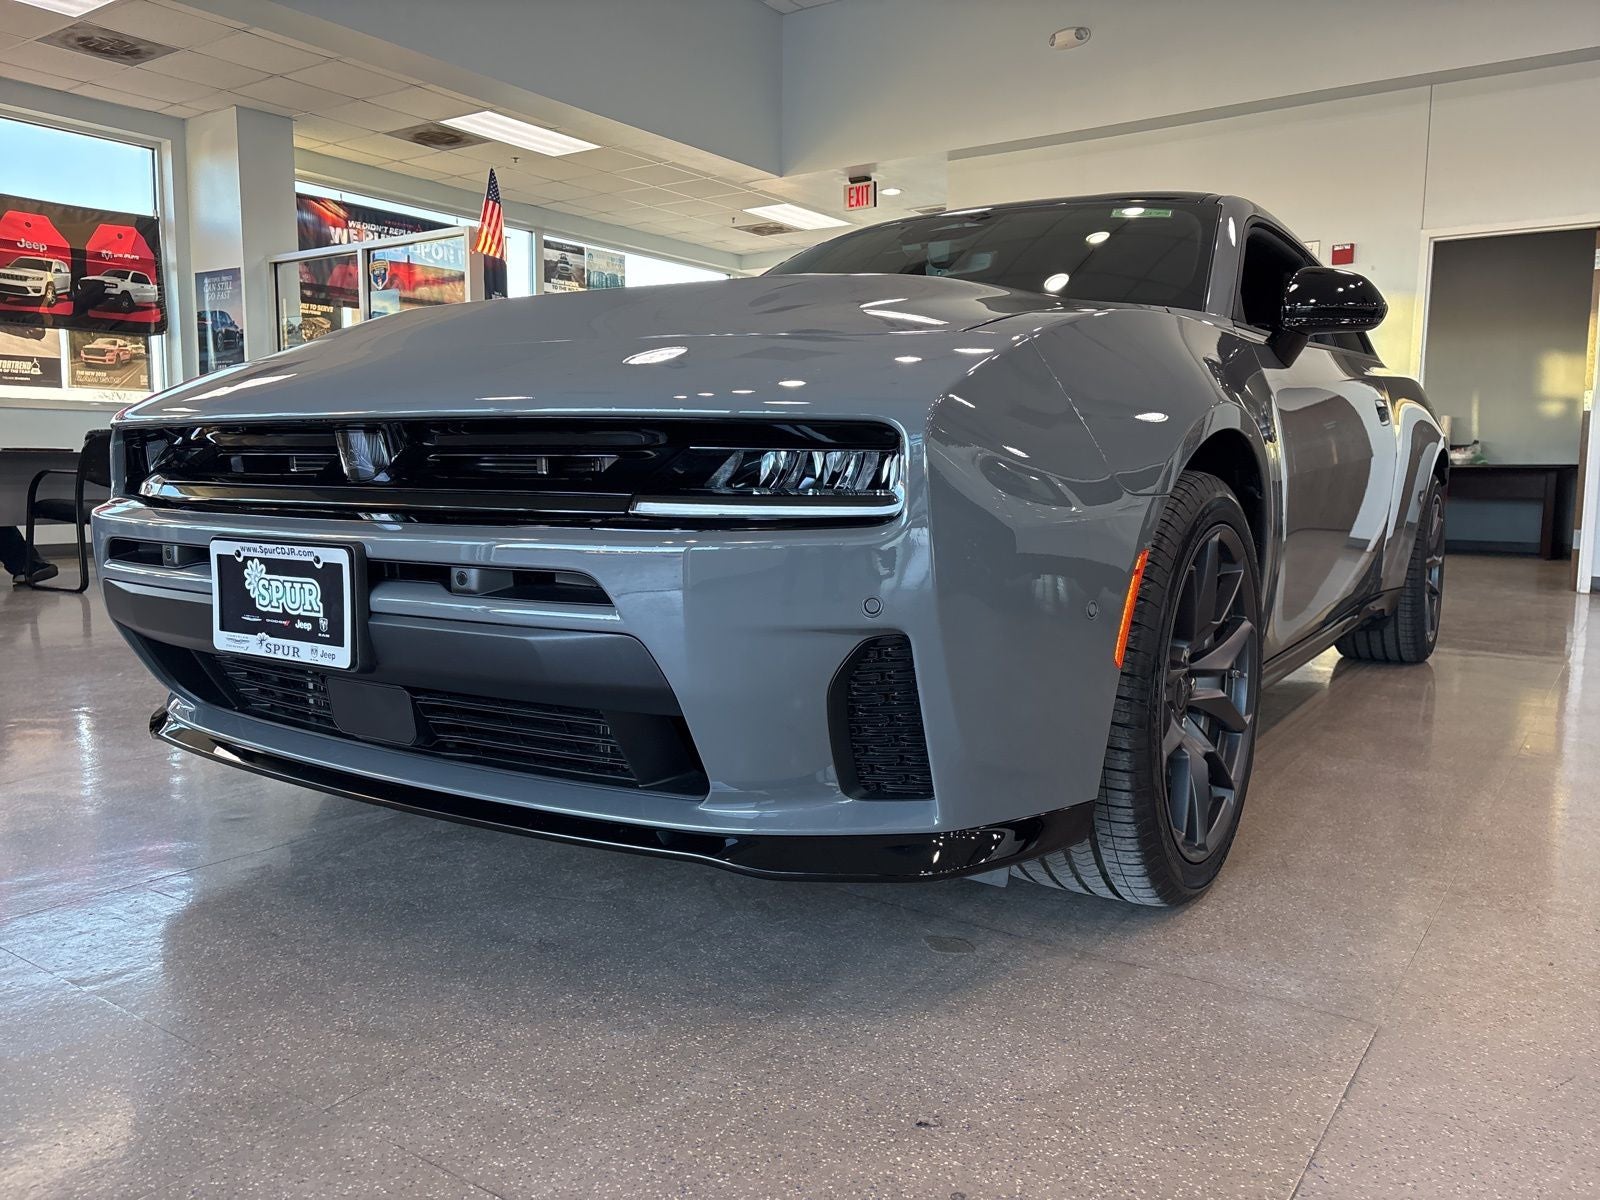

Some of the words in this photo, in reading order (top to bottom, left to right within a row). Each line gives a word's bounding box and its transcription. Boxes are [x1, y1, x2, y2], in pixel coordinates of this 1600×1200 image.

[848, 184, 870, 207] EXIT
[347, 220, 361, 229] WE
[361, 222, 388, 233] DIDN'T
[329, 226, 361, 244] WE
[17, 238, 48, 252] Jeep
[317, 305, 334, 313] SERVE
[240, 545, 315, 557] www.SpurCDJR.com
[257, 576, 321, 614] SPUR
[295, 620, 312, 631] Jeep
[265, 642, 300, 658] SPUR
[320, 650, 336, 661] Jeep
